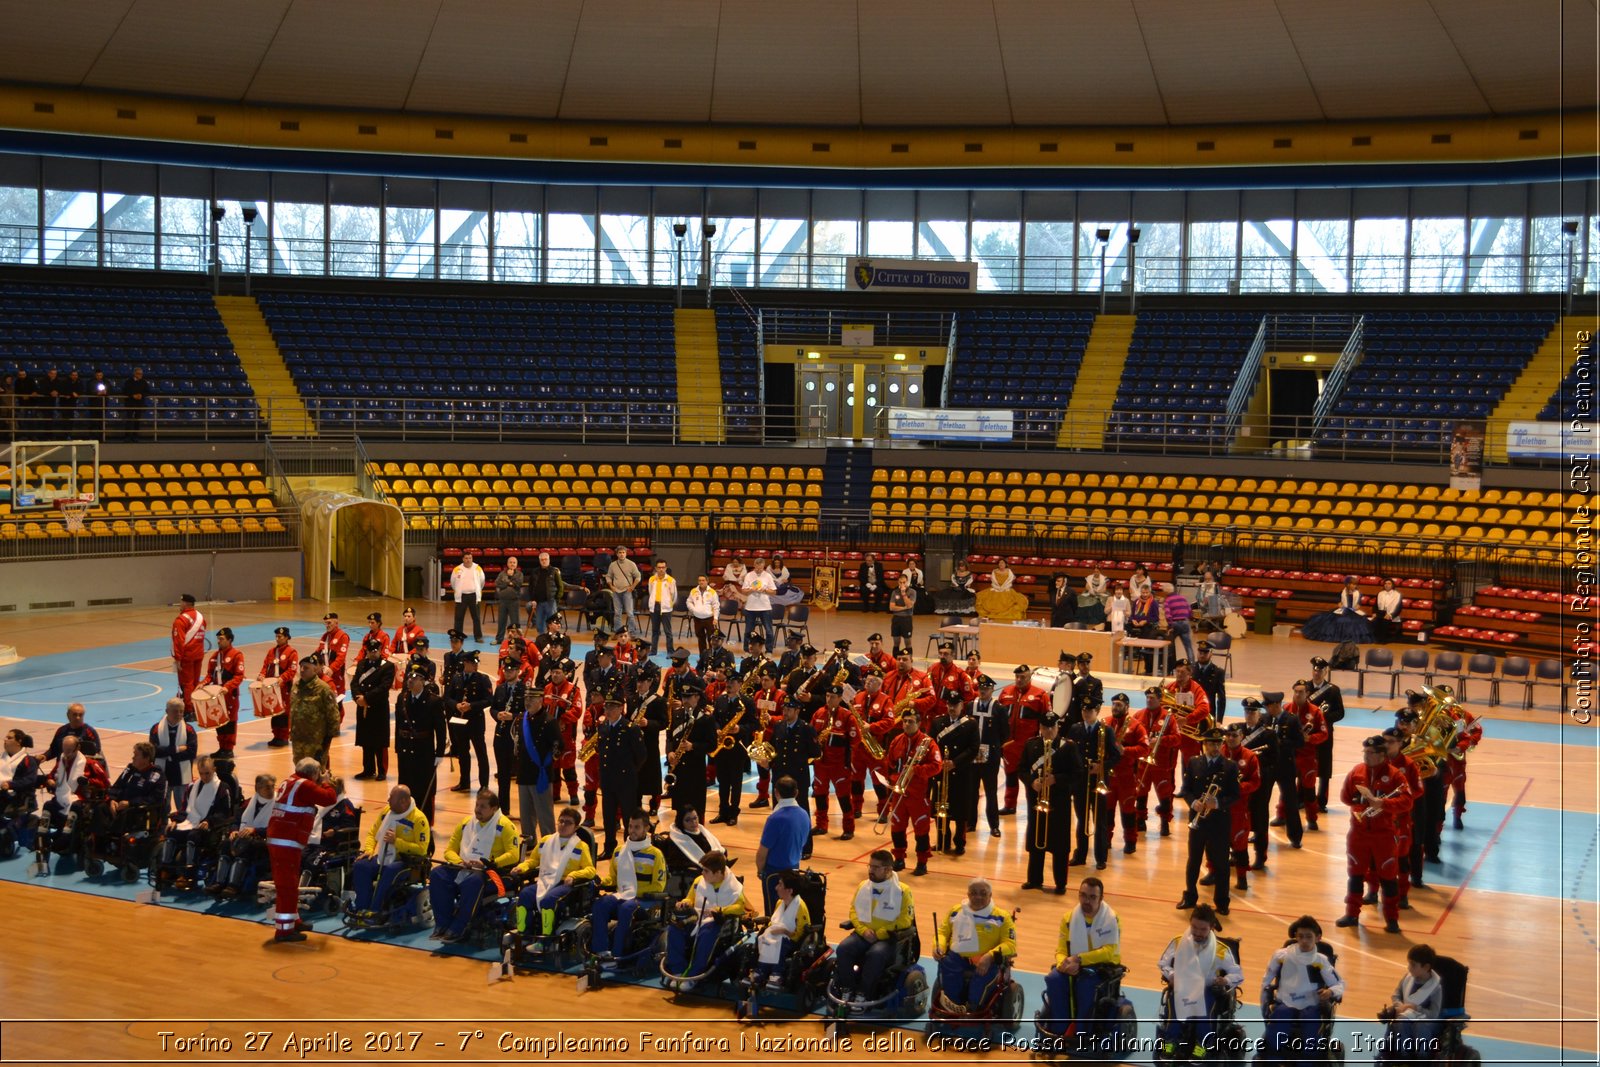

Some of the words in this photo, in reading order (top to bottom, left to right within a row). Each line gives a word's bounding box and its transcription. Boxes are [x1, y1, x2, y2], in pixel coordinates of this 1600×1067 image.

[913, 274, 923, 284] DI
[926, 272, 967, 285] TORINO
[894, 412, 925, 430] Telethon
[935, 414, 966, 431] Telethon
[976, 415, 1008, 432] Telethon
[1513, 428, 1547, 446] Telethon
